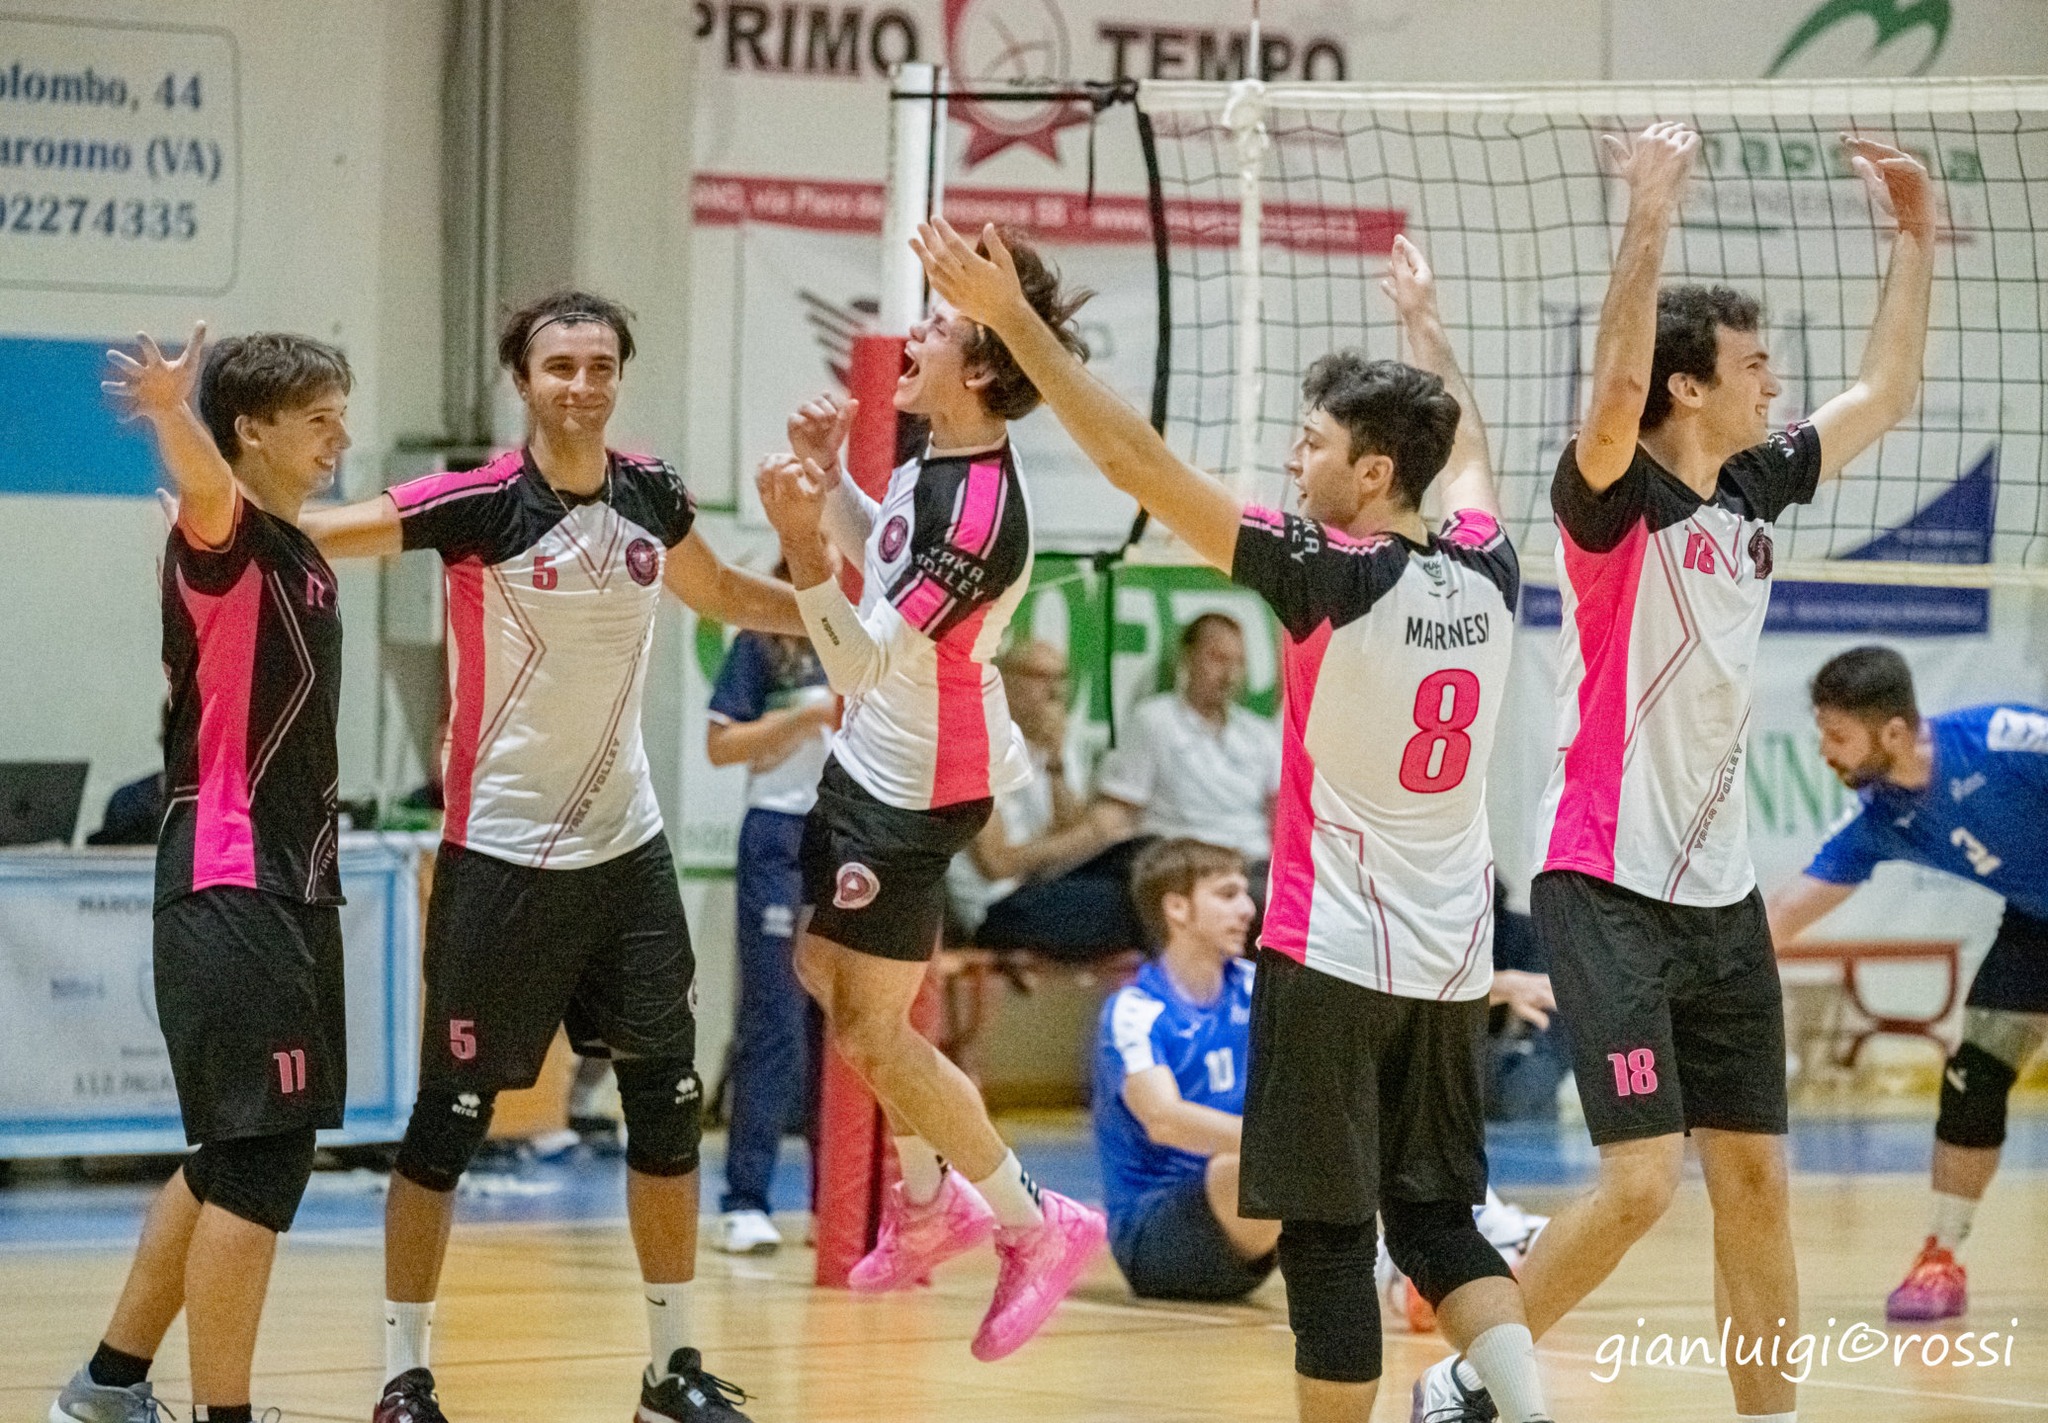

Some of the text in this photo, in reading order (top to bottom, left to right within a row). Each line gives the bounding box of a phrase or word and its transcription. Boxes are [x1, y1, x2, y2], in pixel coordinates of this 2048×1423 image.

[0, 60, 203, 114] lombo, 44
[145, 136, 223, 186] (VA)
[0, 195, 198, 242] 2274335
[533, 556, 558, 590] 5
[929, 547, 985, 583] YAKA
[1399, 668, 1480, 794] 8
[564, 738, 620, 834] YAKA VOLLEY
[1694, 743, 1743, 849] YAKA VOLLEY
[449, 1019, 477, 1060] 5
[273, 1048, 306, 1094] 11
[1205, 1047, 1235, 1093] 10
[1607, 1047, 1659, 1097] 18
